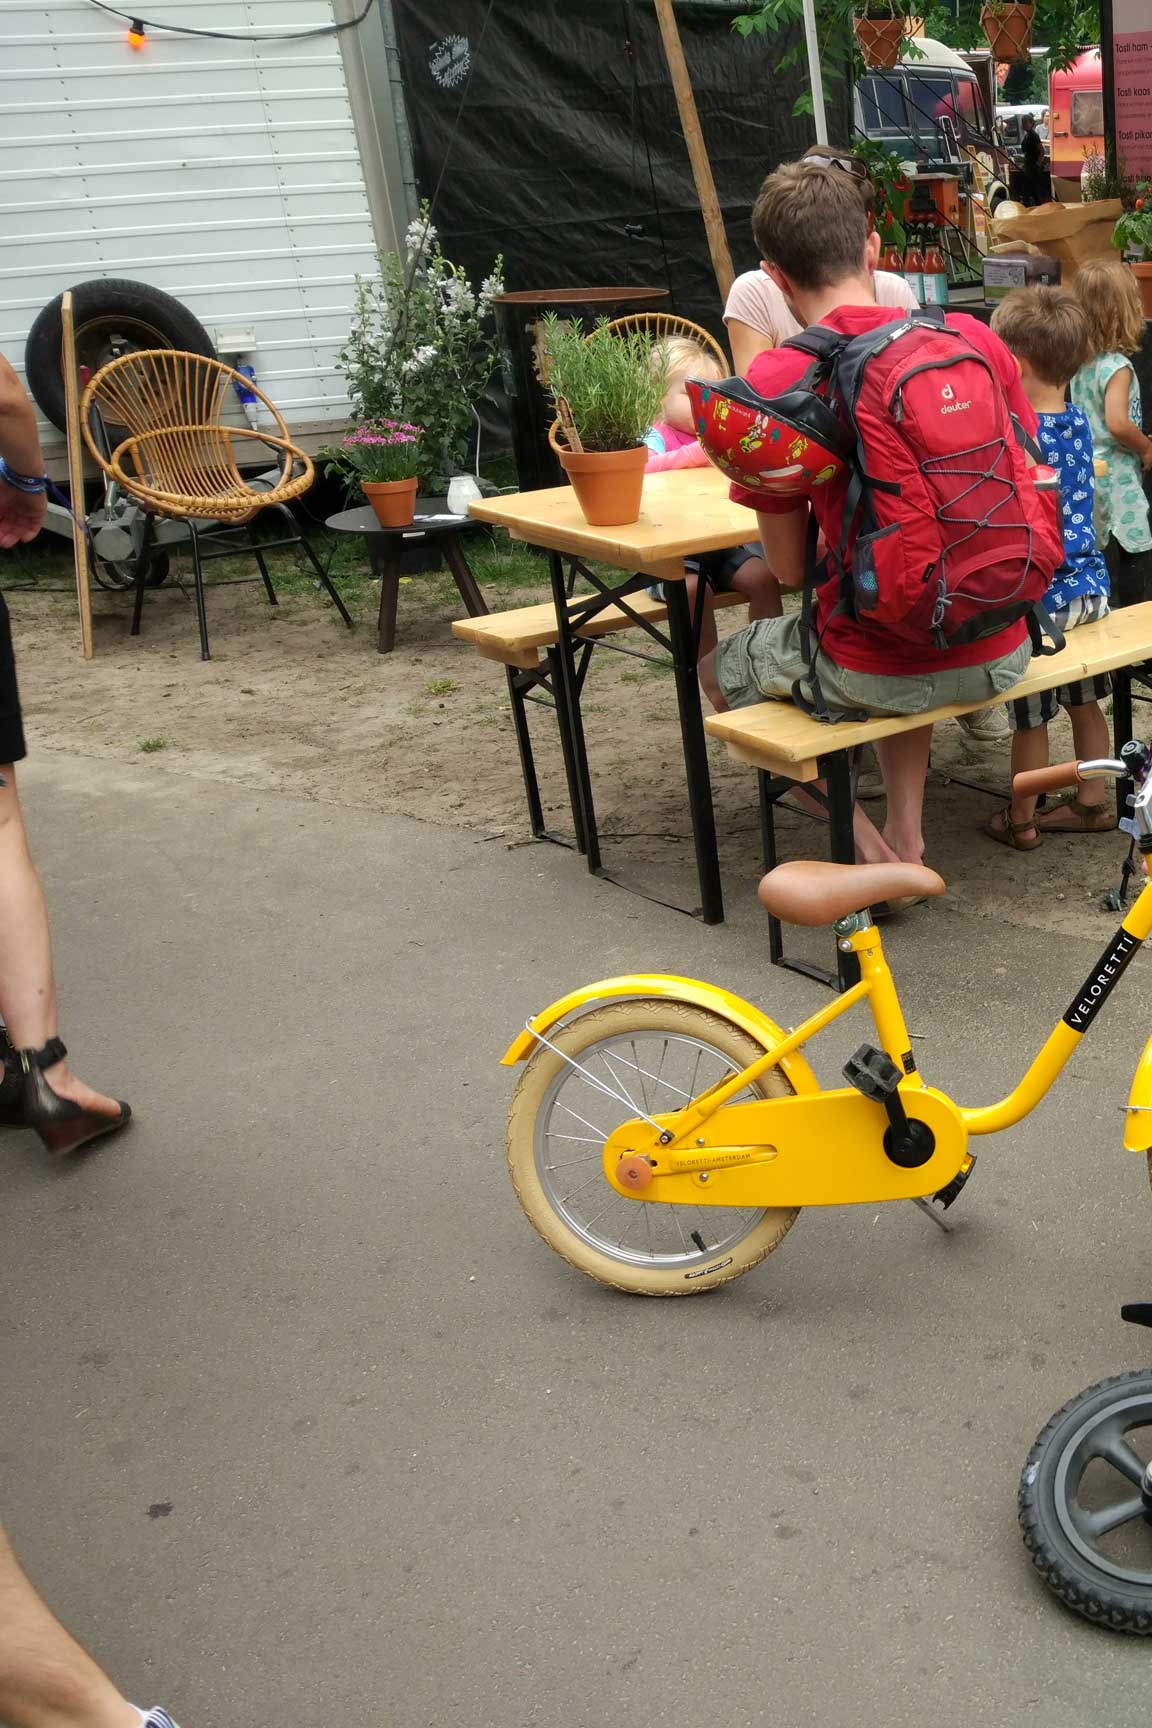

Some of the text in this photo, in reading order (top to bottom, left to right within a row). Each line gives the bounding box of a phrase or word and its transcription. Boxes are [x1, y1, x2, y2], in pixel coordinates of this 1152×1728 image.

[1115, 43, 1131, 53] Tosti
[1133, 42, 1149, 52] ham
[1117, 87, 1132, 97] Tosti
[1133, 86, 1150, 96] kaas
[1118, 130, 1133, 140] Tosti
[940, 400, 973, 415] deuter
[1070, 936, 1134, 1024] VELORETTI
